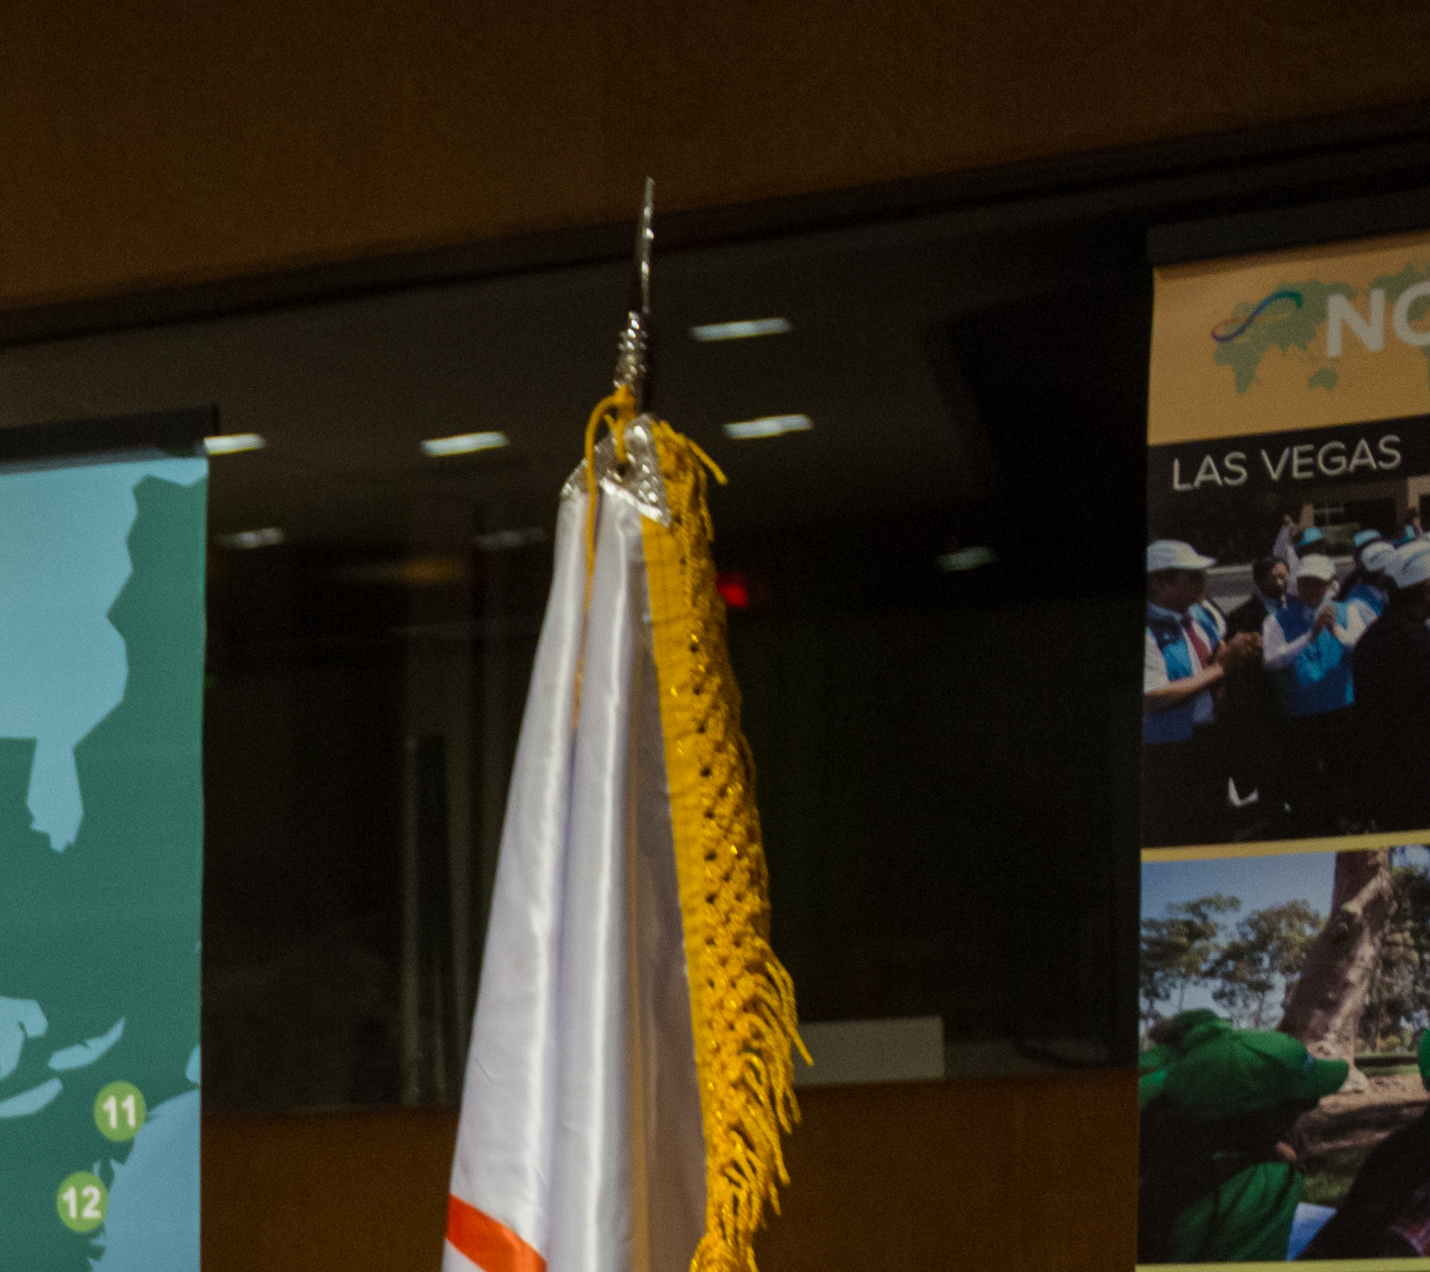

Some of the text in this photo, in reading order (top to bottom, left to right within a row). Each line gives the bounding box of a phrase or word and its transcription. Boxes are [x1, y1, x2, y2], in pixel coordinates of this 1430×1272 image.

[1173, 435, 1402, 491] LAS VEGAS
[103, 1094, 136, 1129] 11
[62, 1185, 101, 1219] 12
